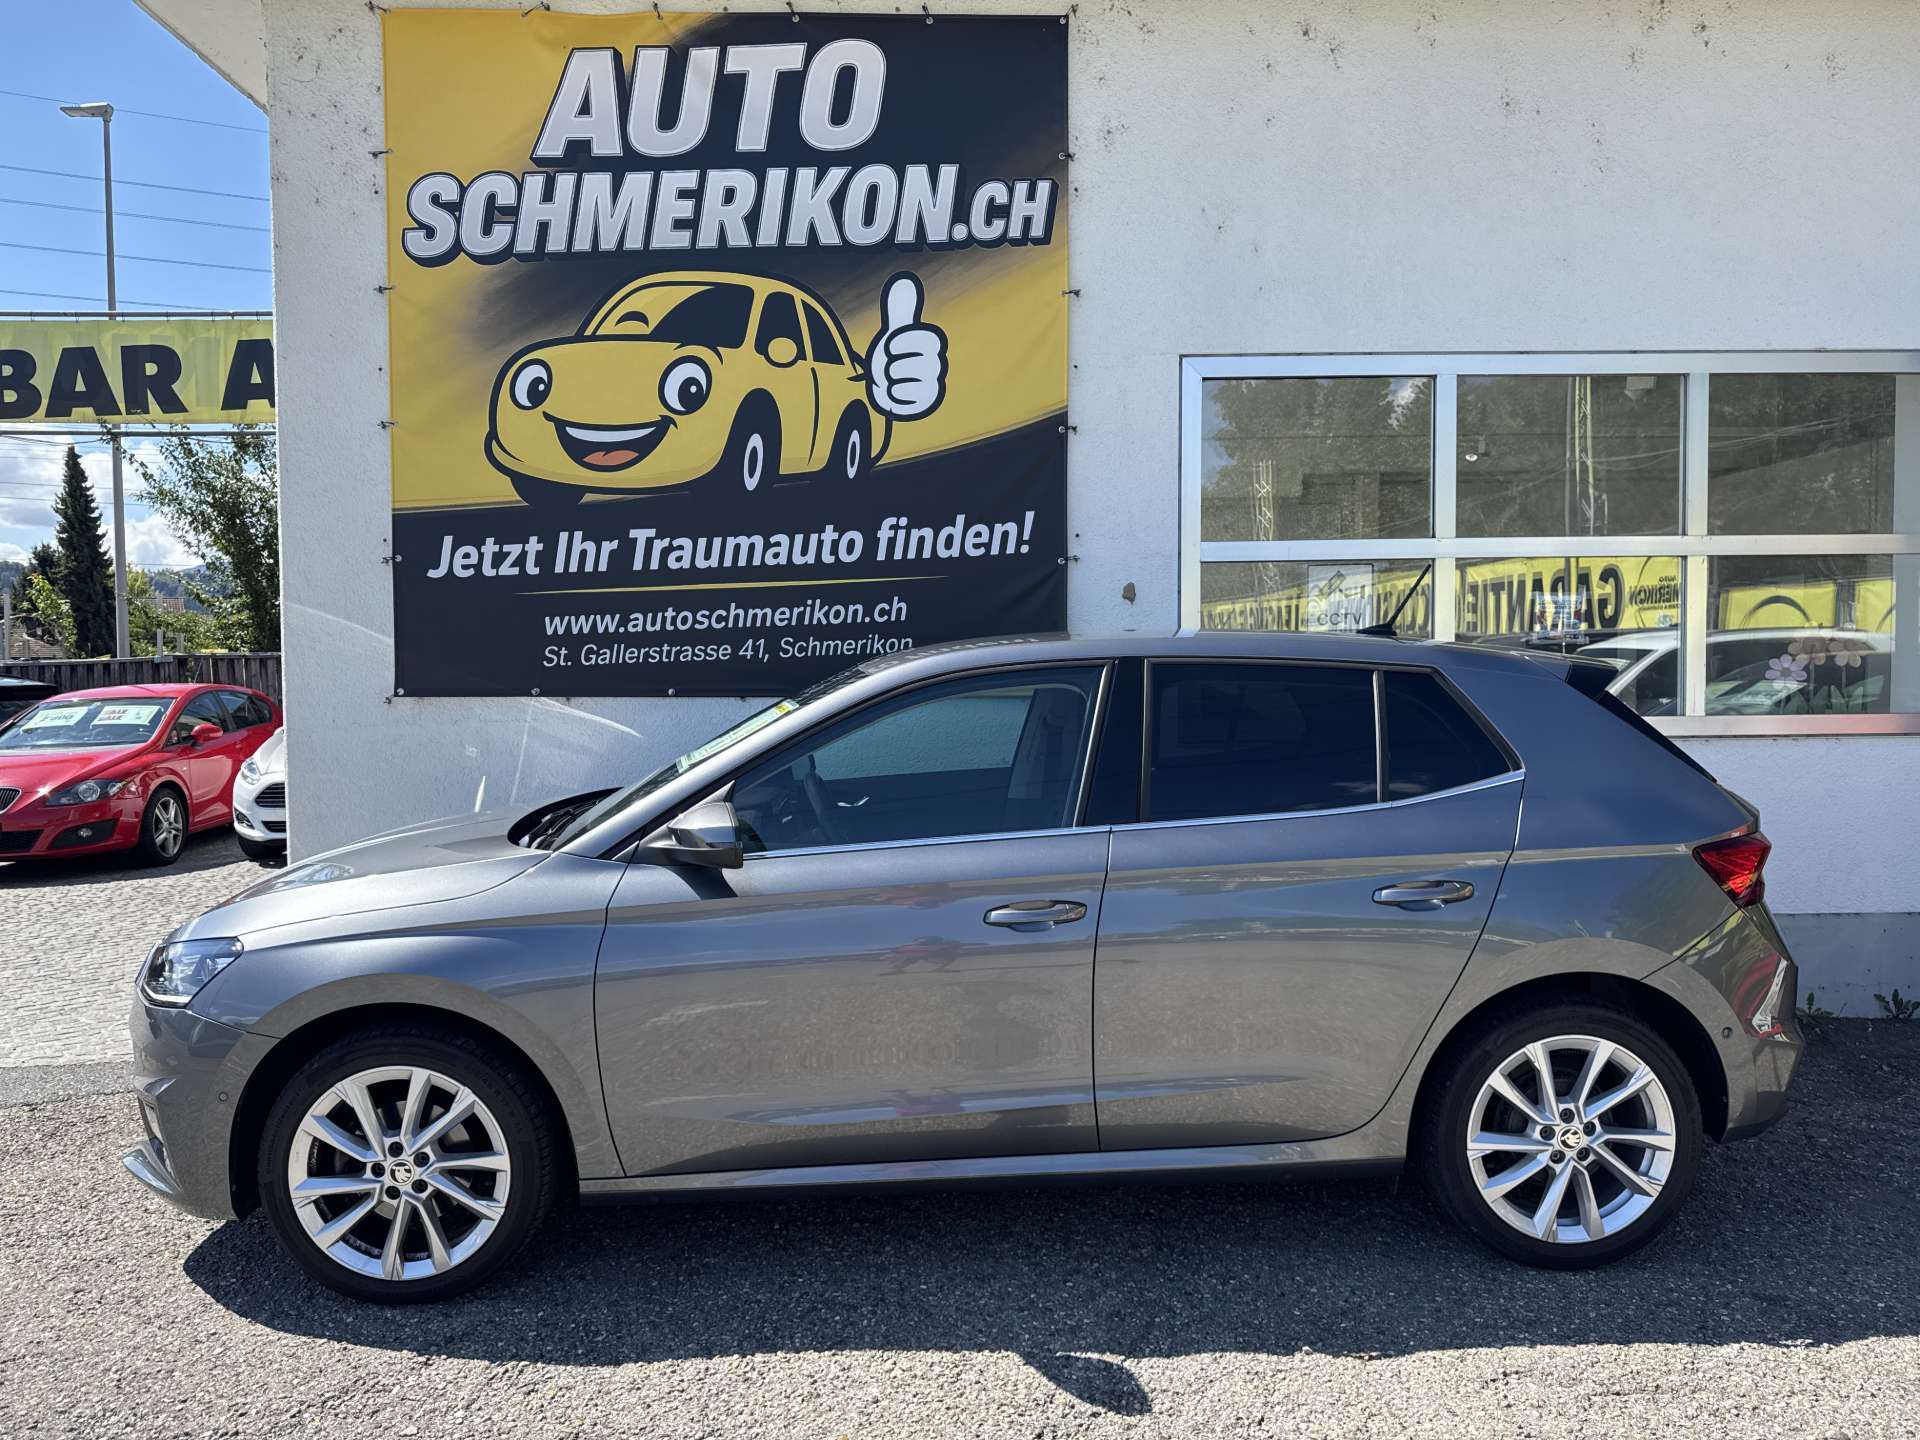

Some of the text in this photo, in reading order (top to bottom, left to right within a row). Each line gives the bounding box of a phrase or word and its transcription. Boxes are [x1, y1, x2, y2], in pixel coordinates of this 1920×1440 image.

[531, 38, 888, 159] AUTO
[403, 162, 1054, 260] SCHMERIKON.CH
[427, 510, 1036, 579] Jetzt Ihr Traumauto finden!
[544, 596, 908, 635] www.autoschmerikon.ch
[1317, 612, 1362, 626] CCTV
[542, 633, 913, 668] St. Gallerstrasse 41, Schmerikon
